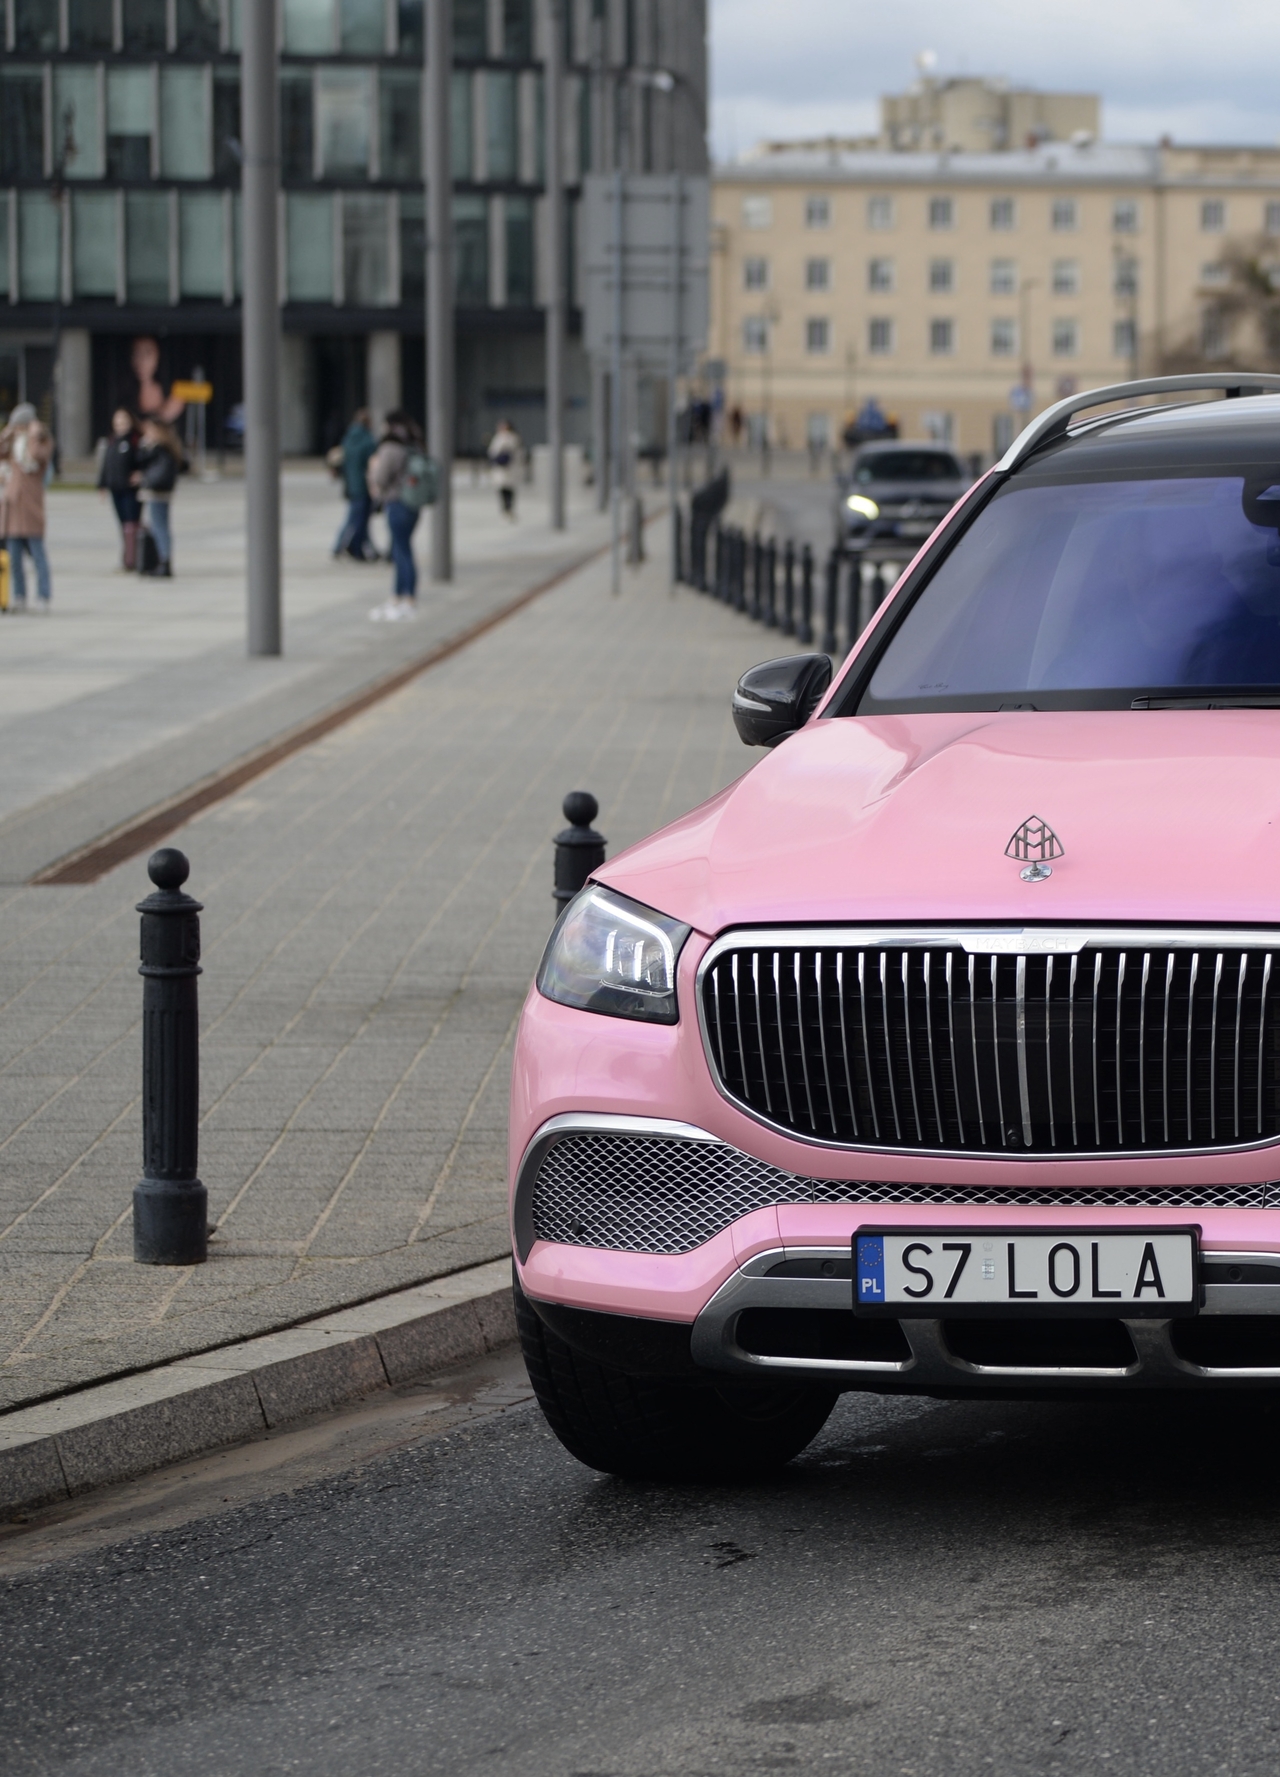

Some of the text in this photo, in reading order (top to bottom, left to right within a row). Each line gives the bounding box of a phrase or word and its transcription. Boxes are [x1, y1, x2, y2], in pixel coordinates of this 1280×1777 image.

[975, 937, 1069, 950] MAYBACH
[901, 1241, 1166, 1299] S7 LOLA
[861, 1278, 882, 1293] PL
